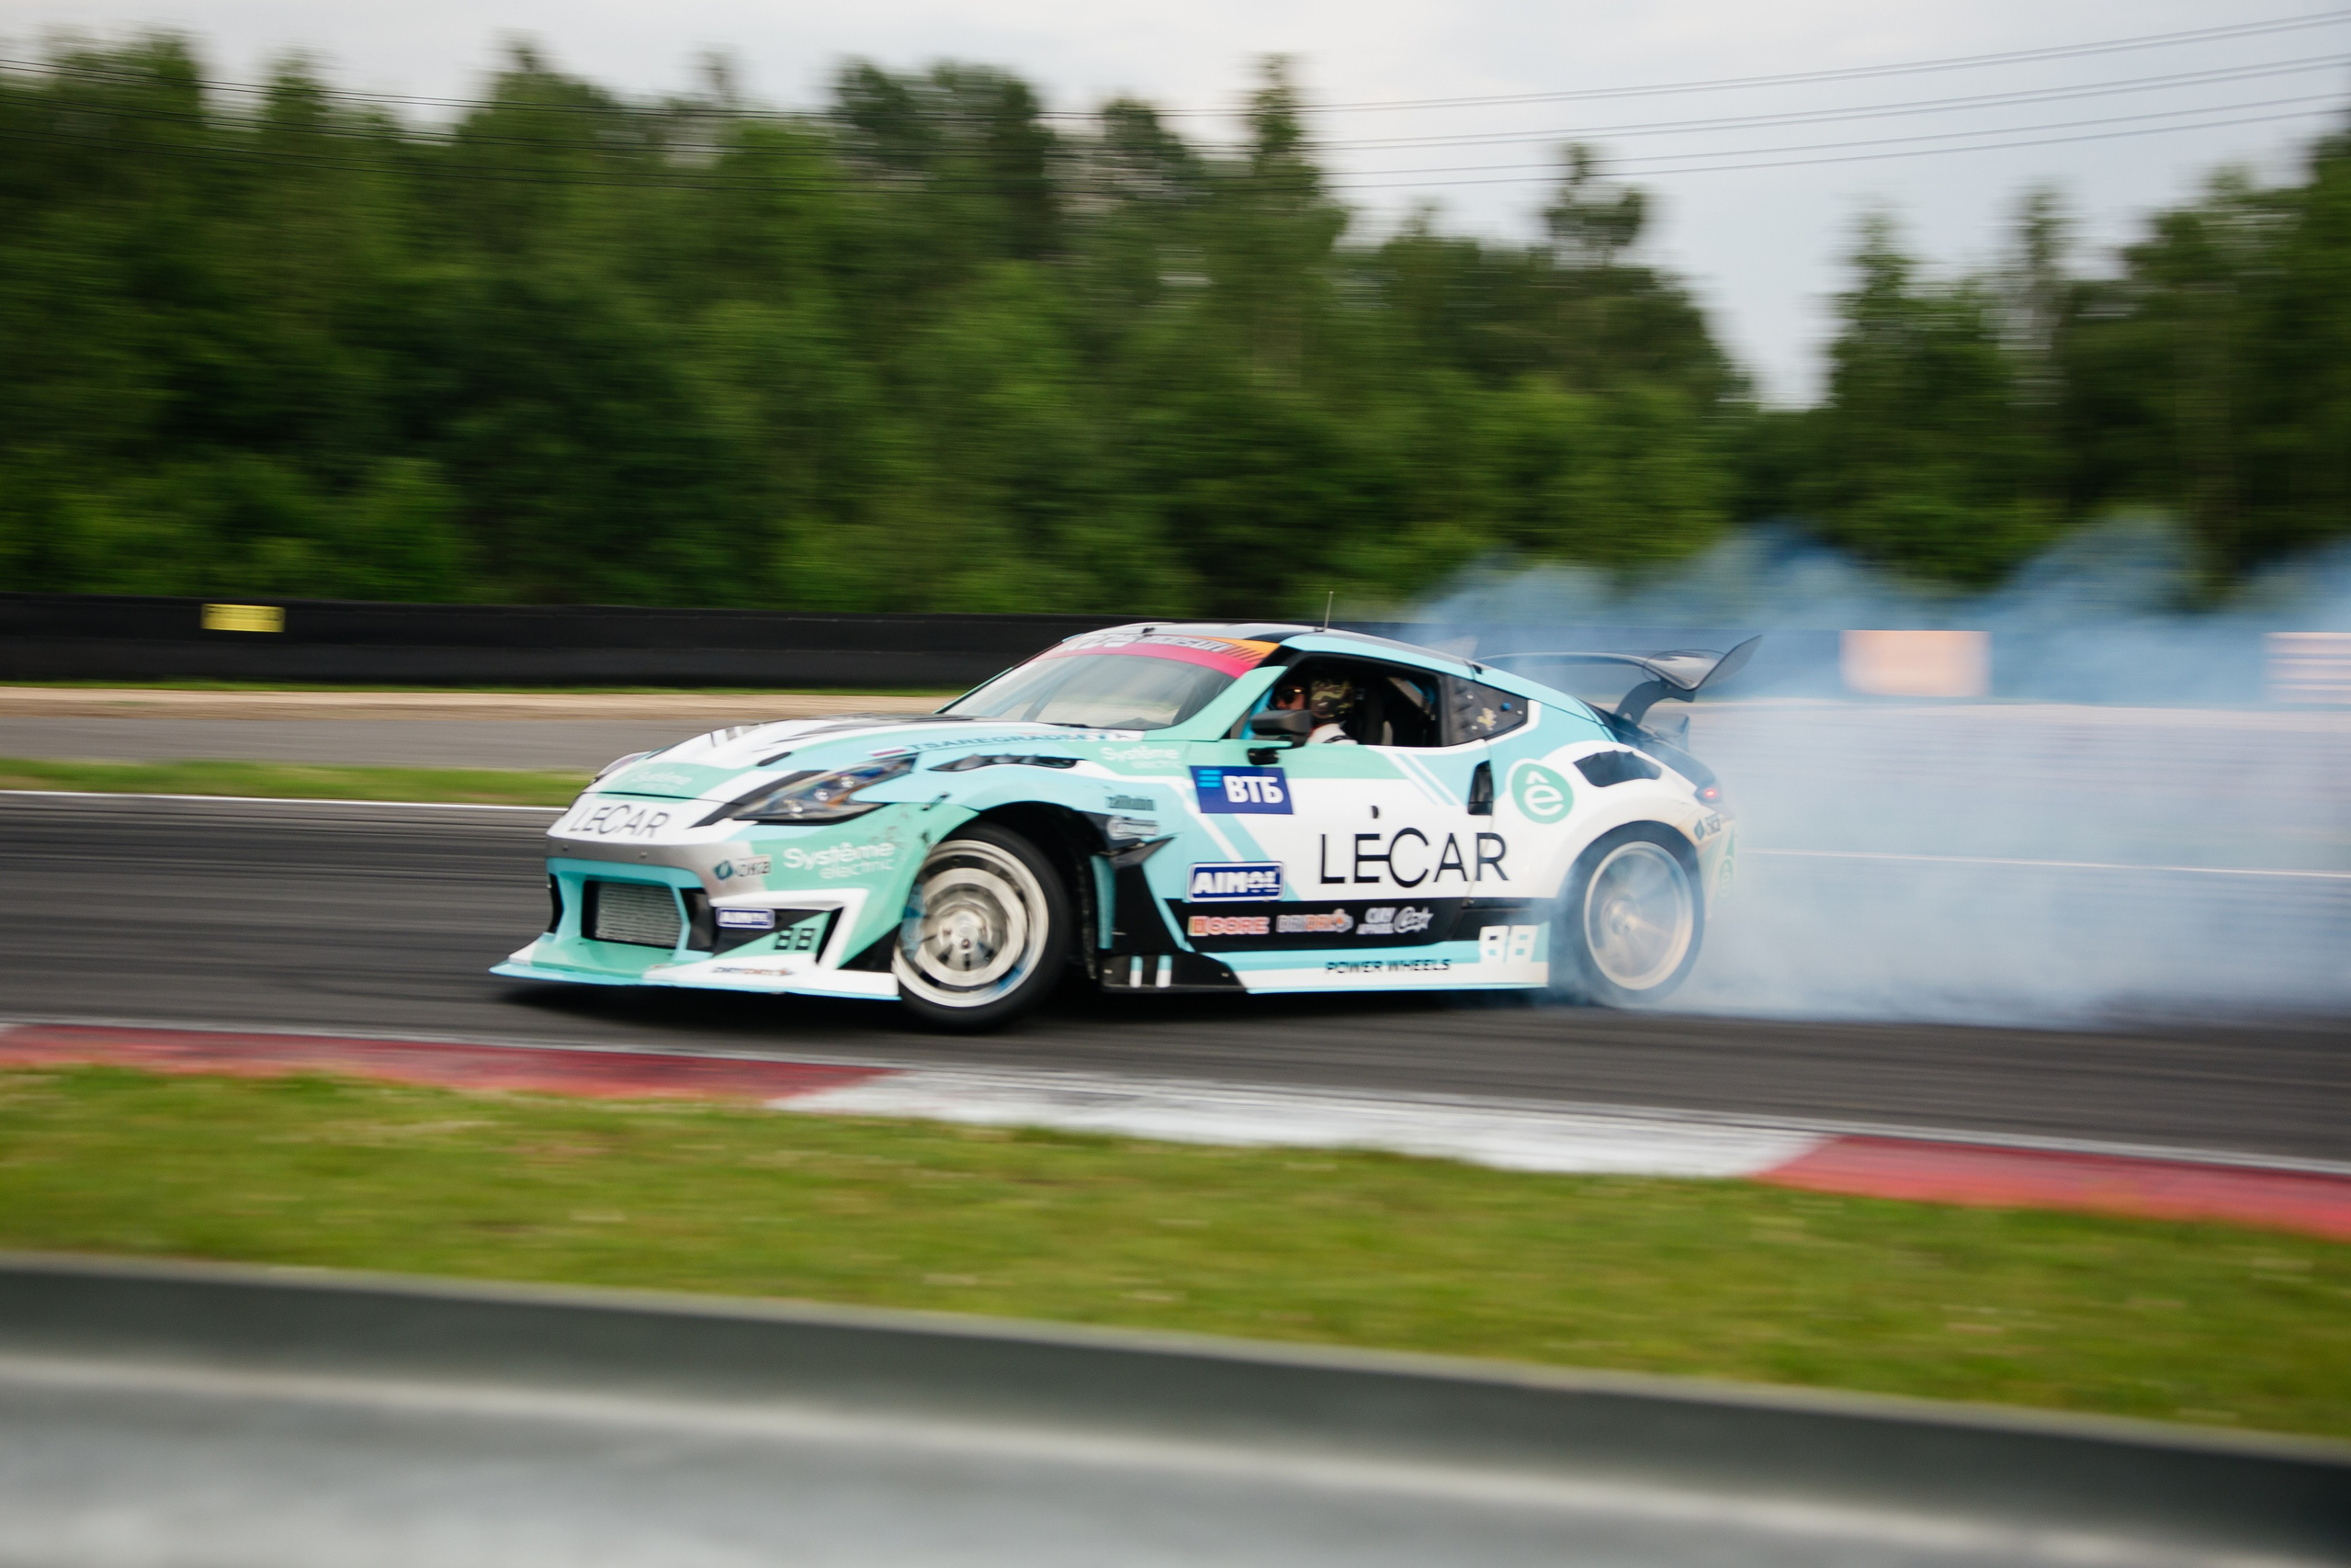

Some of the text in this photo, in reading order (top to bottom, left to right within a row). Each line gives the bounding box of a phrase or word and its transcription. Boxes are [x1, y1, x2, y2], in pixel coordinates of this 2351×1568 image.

[1223, 775, 1284, 804] ВТБ
[568, 804, 671, 839] LECAR
[1319, 827, 1509, 888] LECAR
[1192, 871, 1282, 895] AIMOL
[774, 928, 817, 950] 88
[1479, 925, 1539, 963] 88
[1325, 959, 1452, 974] POWER WHEELS
